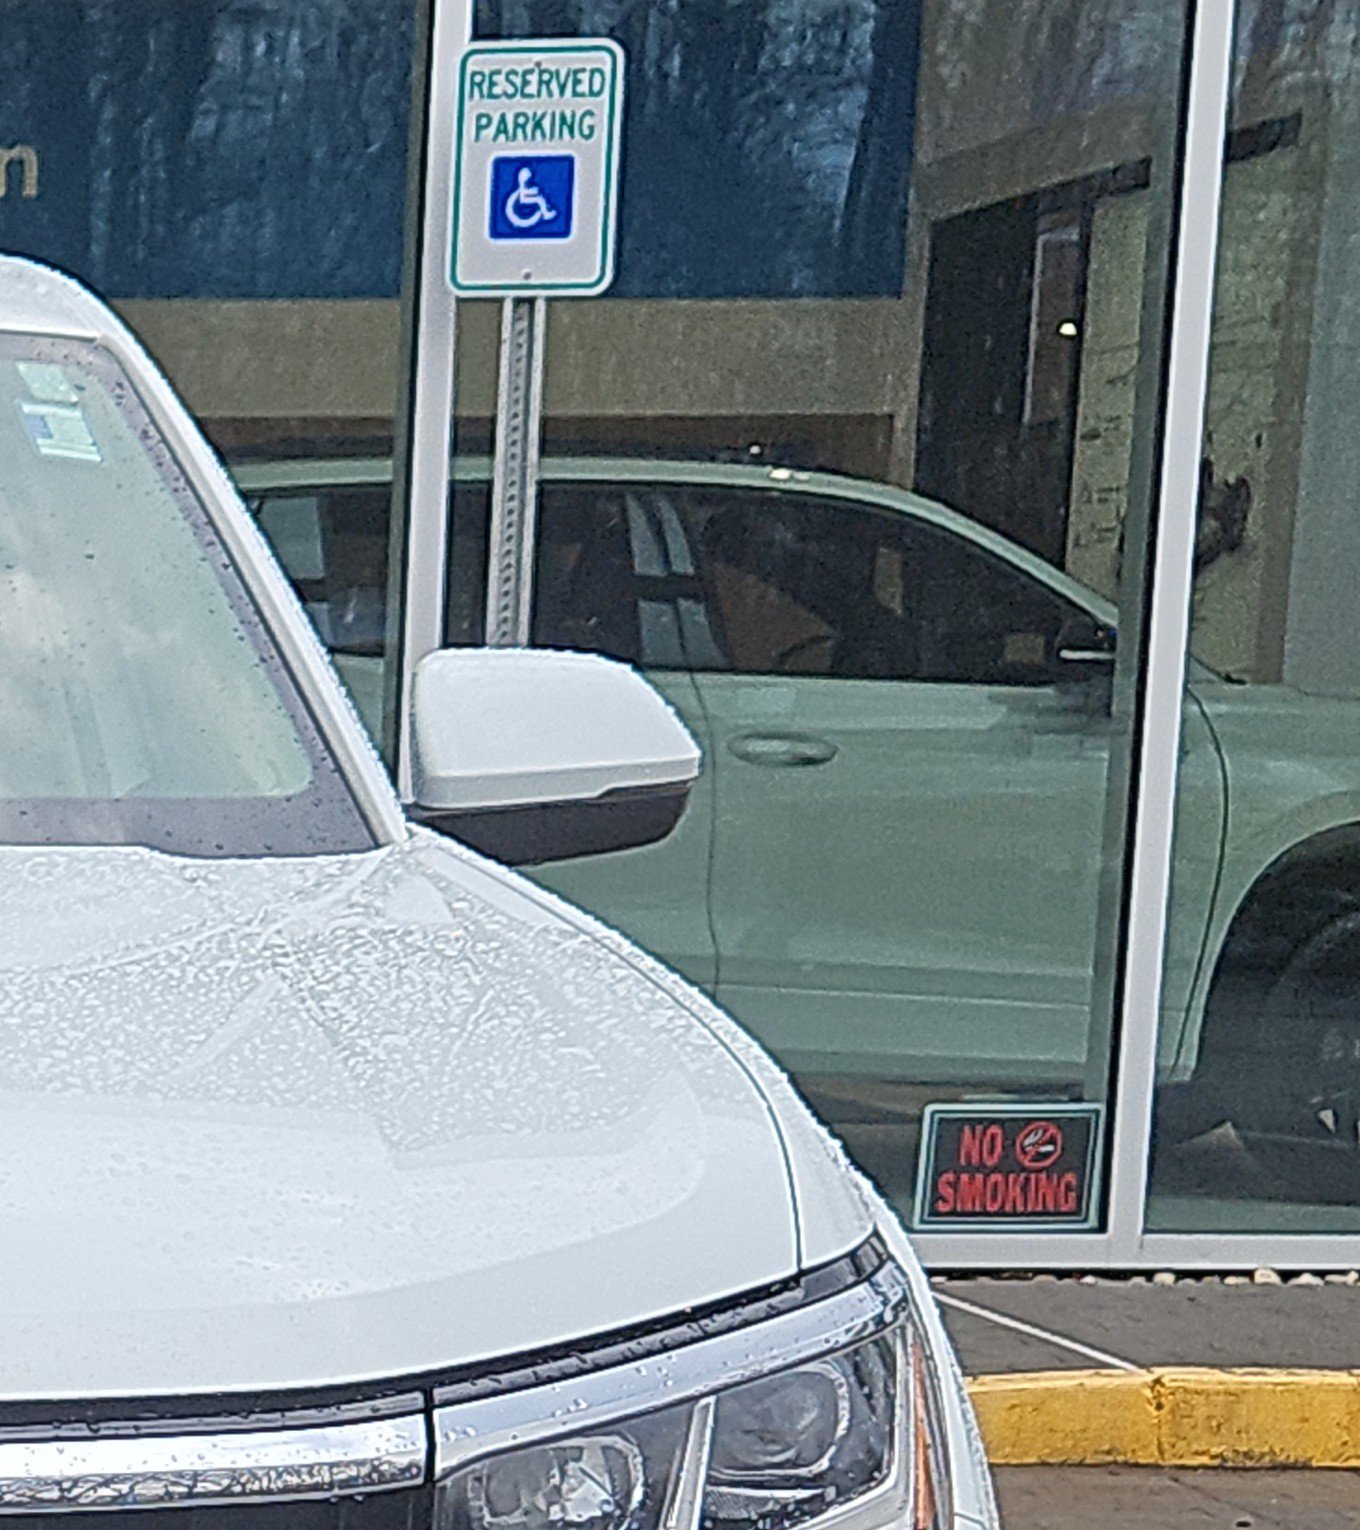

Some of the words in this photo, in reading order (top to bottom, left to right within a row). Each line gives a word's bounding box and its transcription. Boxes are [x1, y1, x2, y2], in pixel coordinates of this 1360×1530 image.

[468, 67, 606, 100] RESERVED
[473, 109, 596, 143] PARKING
[960, 1124, 1004, 1167] NO
[936, 1171, 1077, 1213] SMOKING
